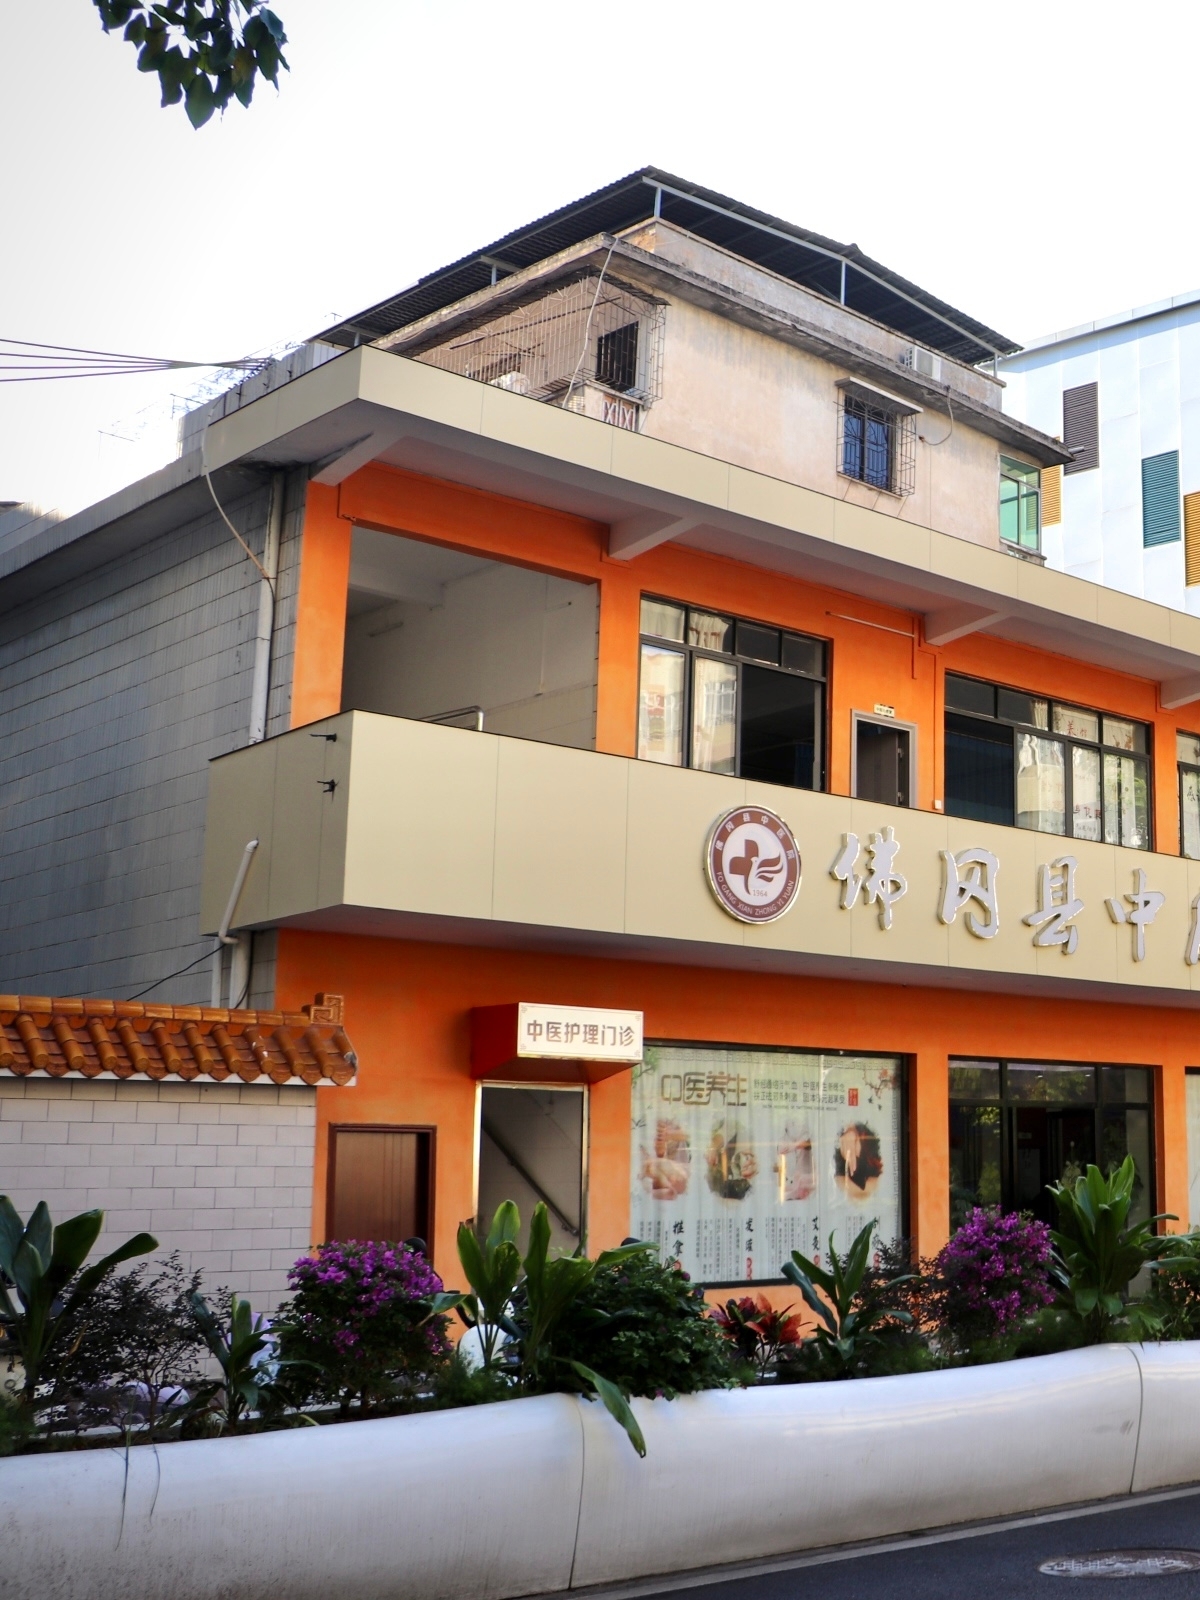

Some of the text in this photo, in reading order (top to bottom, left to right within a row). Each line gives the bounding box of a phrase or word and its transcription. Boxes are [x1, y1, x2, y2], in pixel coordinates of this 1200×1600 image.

[714, 812, 796, 861] 佛冈县中医院
[715, 871, 795, 917] FO GANG XIAN ZHONG YI YUAN
[752, 889, 768, 898] 1964
[526, 1019, 636, 1048] 中医护理门诊
[660, 1070, 748, 1107] 中医养生
